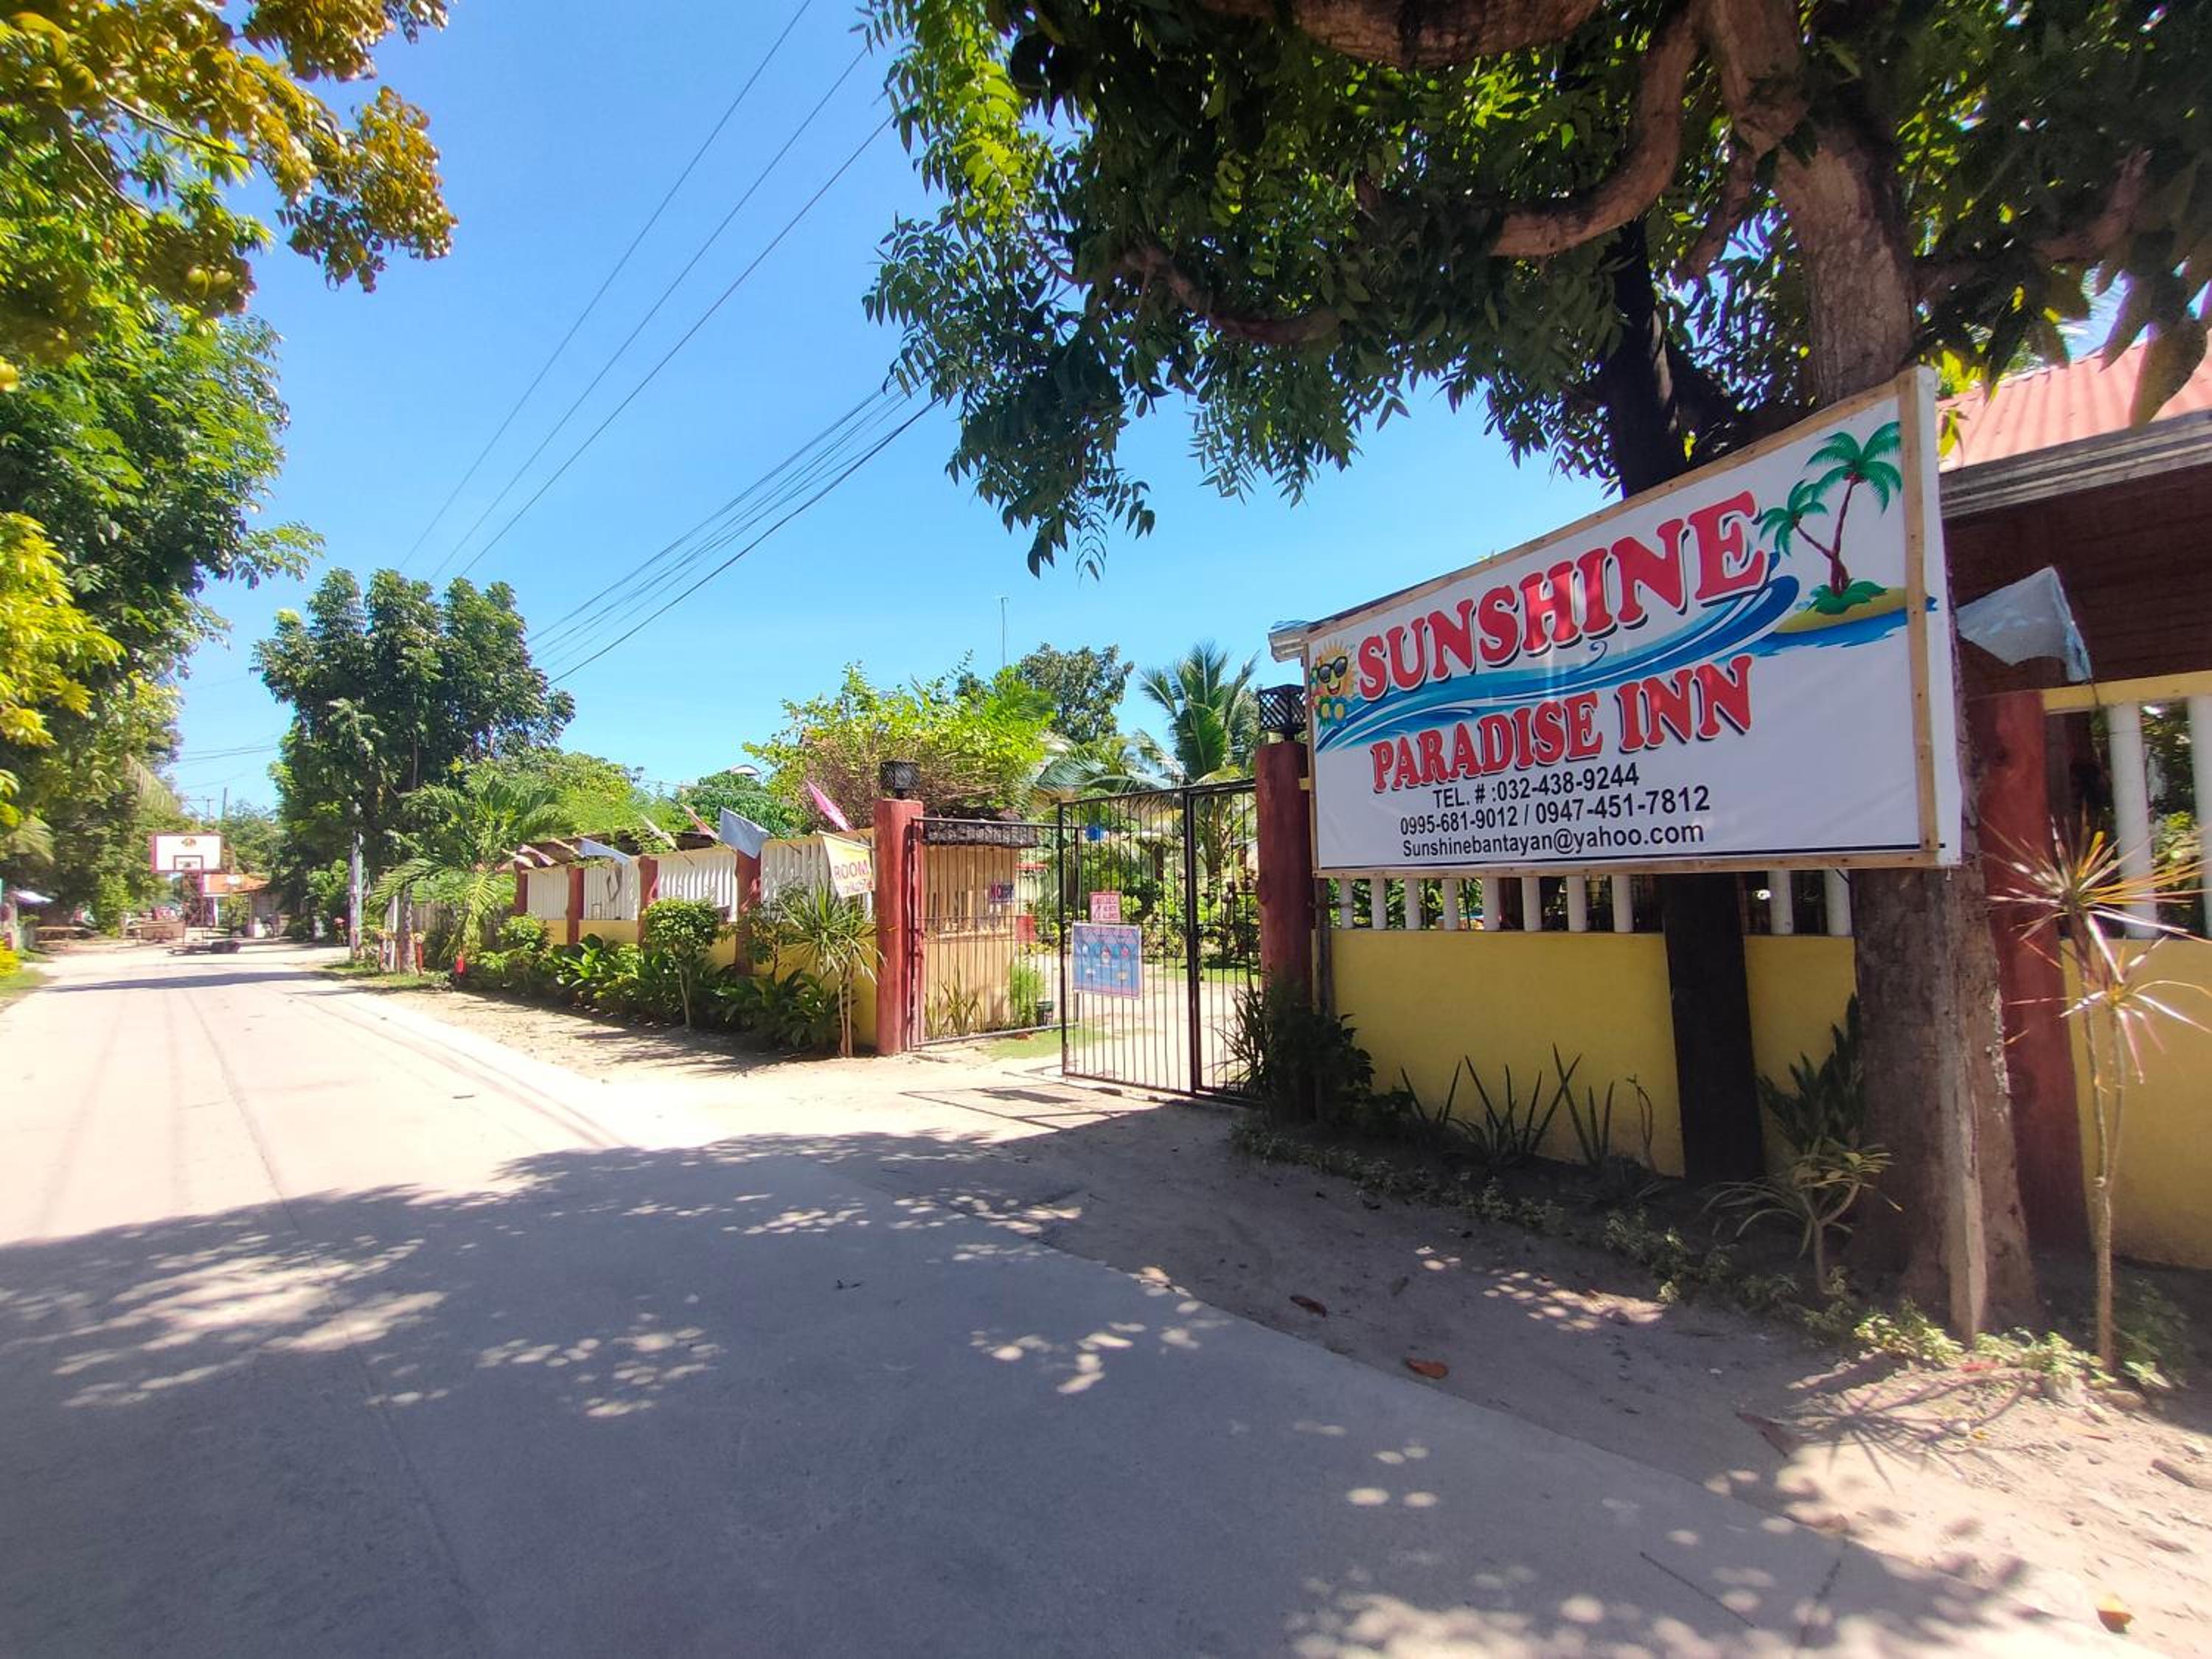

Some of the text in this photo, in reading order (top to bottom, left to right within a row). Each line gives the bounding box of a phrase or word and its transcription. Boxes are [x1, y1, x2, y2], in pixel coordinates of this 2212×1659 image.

[1357, 490, 1767, 700] SUNSHINE
[1371, 654, 1753, 793] PARADISE INN
[1400, 807, 1518, 835] 0995-681-9012
[1536, 785, 1711, 824] 0947-451-7812
[1433, 788, 1470, 809] TEL.
[1403, 823, 1705, 857] Sunshinebantayan@yahoo.com
